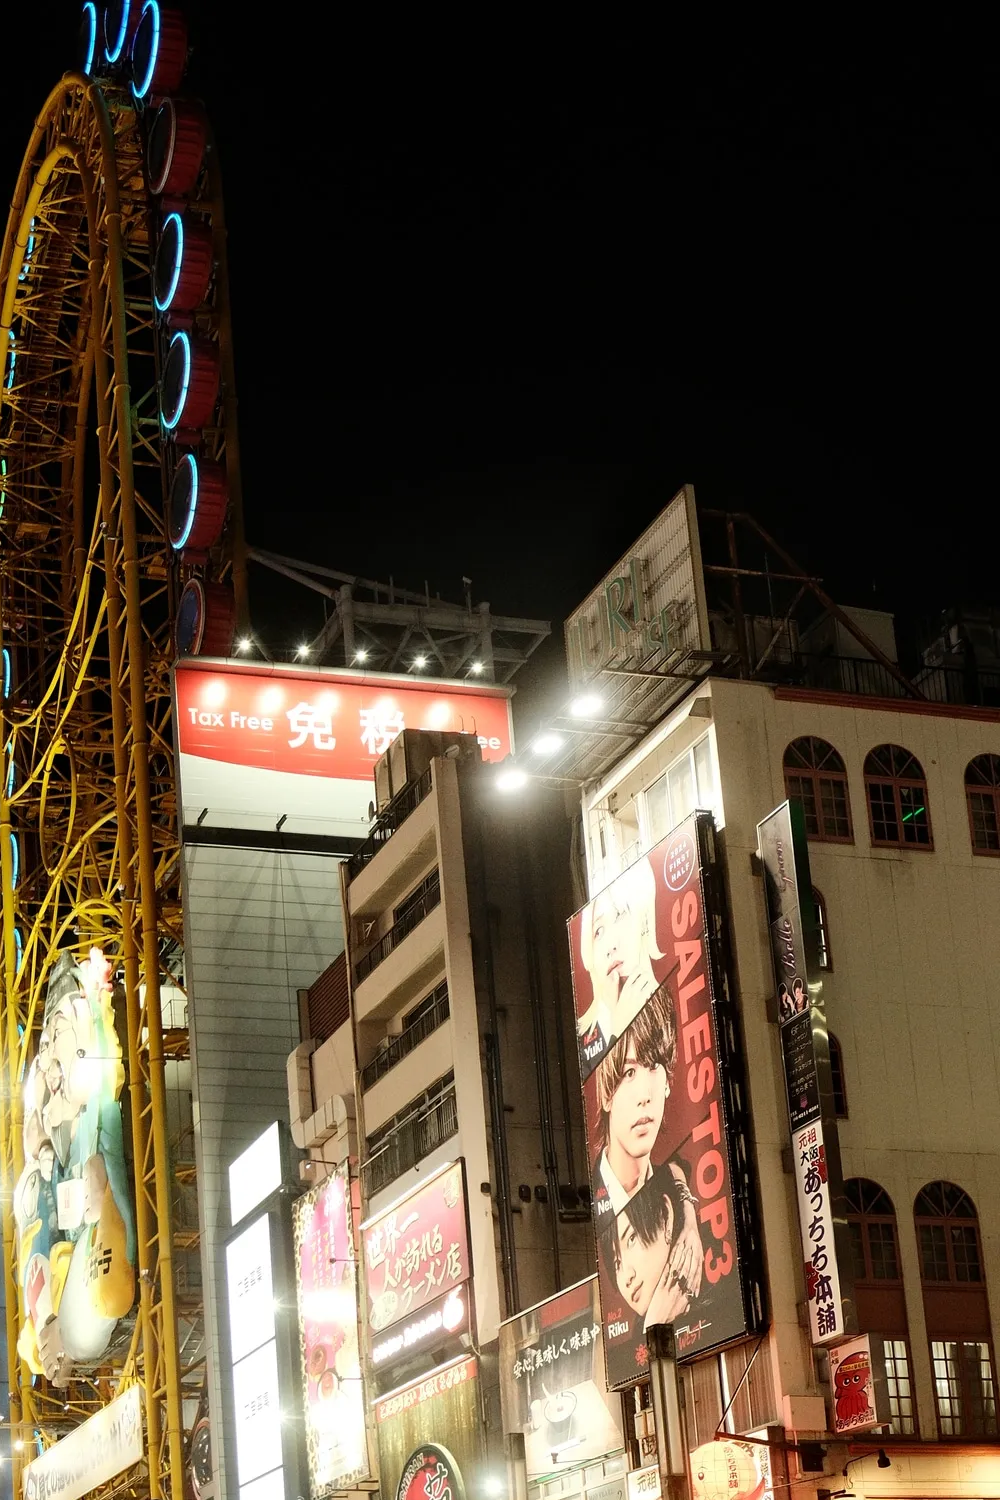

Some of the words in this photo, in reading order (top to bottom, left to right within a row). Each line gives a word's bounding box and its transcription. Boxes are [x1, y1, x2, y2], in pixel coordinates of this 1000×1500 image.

[188, 707, 224, 728] Tax
[230, 711, 274, 732] Free
[669, 849, 690, 873] FIRST
[671, 862, 690, 883] HALF
[584, 1037, 603, 1061] Yuki
[798, 1127, 817, 1150] 元祖
[800, 1144, 819, 1167] 大阪
[367, 1212, 419, 1270] 世界一
[804, 1166, 837, 1337] あっちち本舗
[384, 1224, 443, 1292] 人が訪れる
[401, 1243, 463, 1312] ラーメン店
[607, 1308, 623, 1322] No.2
[607, 1321, 629, 1340] Riku
[636, 1468, 658, 1494] 元祖
